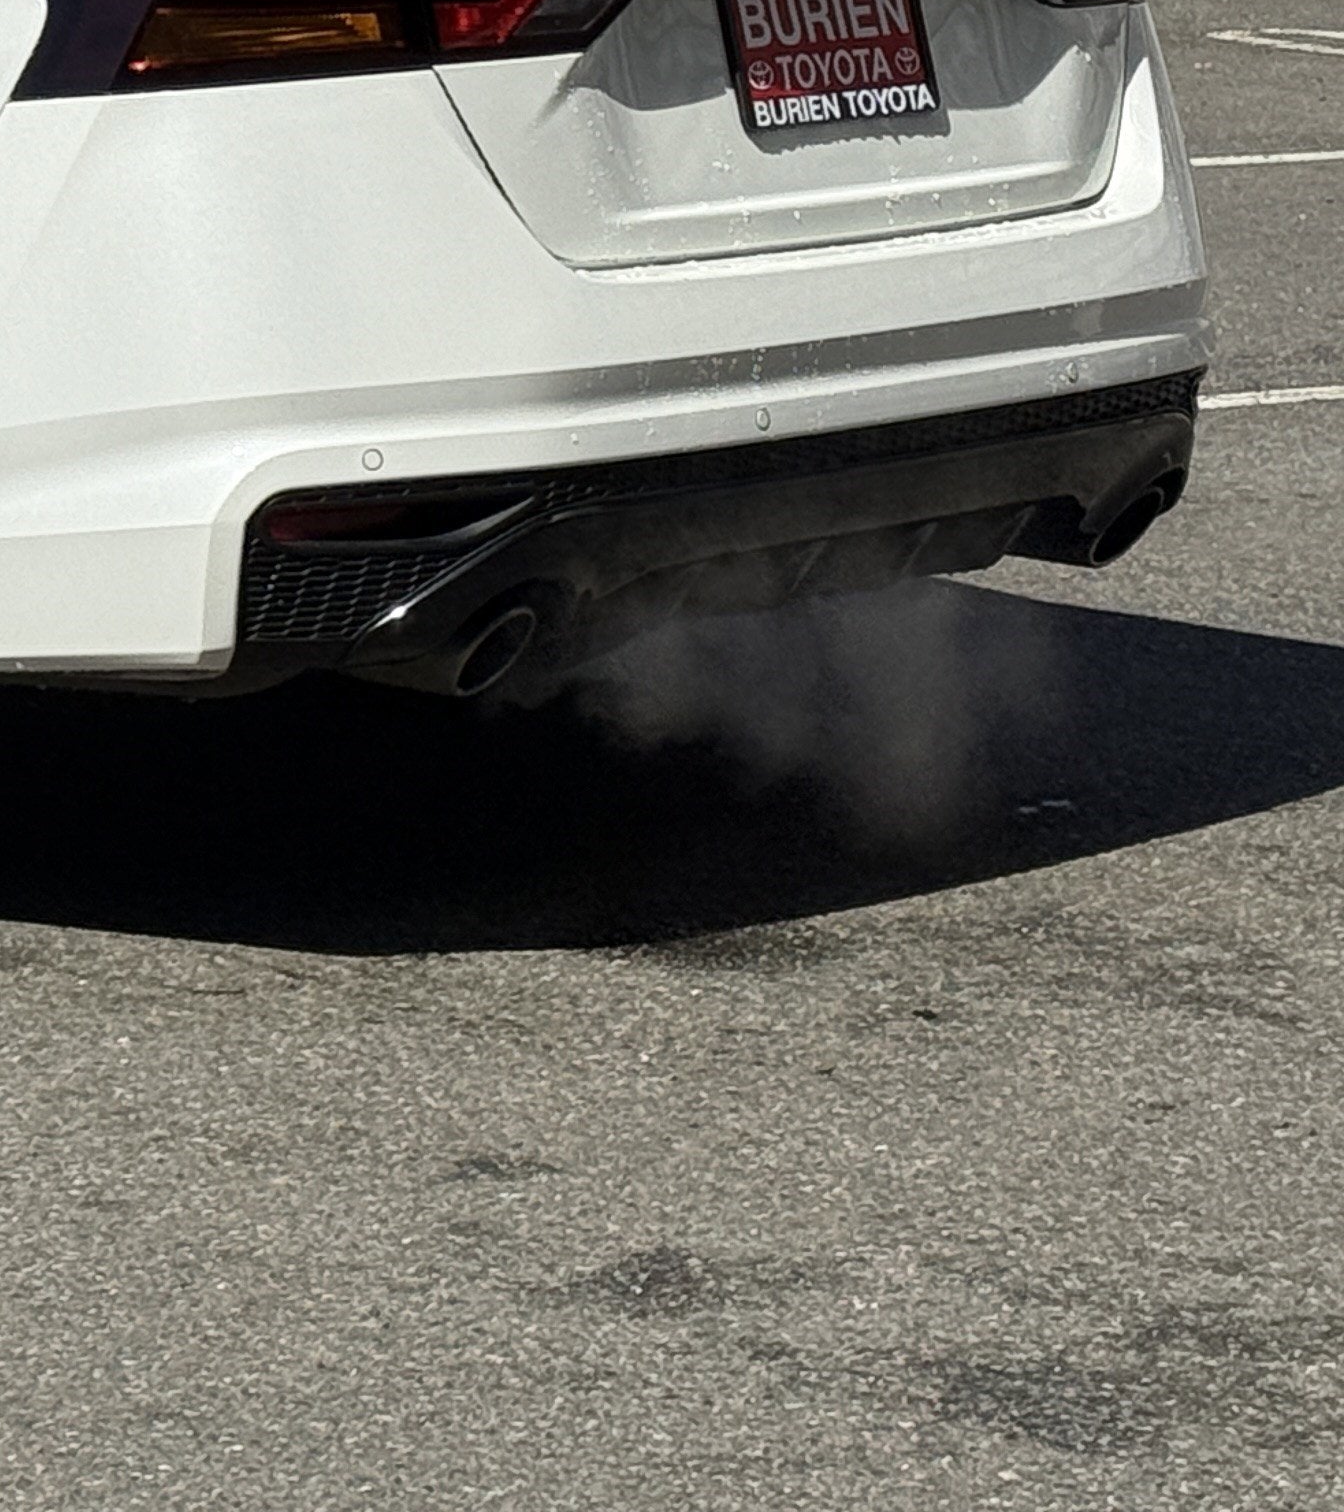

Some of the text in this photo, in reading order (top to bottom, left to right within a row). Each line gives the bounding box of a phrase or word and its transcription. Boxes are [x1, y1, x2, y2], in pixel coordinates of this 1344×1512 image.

[775, 46, 895, 91] TOYOTA
[752, 83, 936, 127] BURIEN TOYOTA
